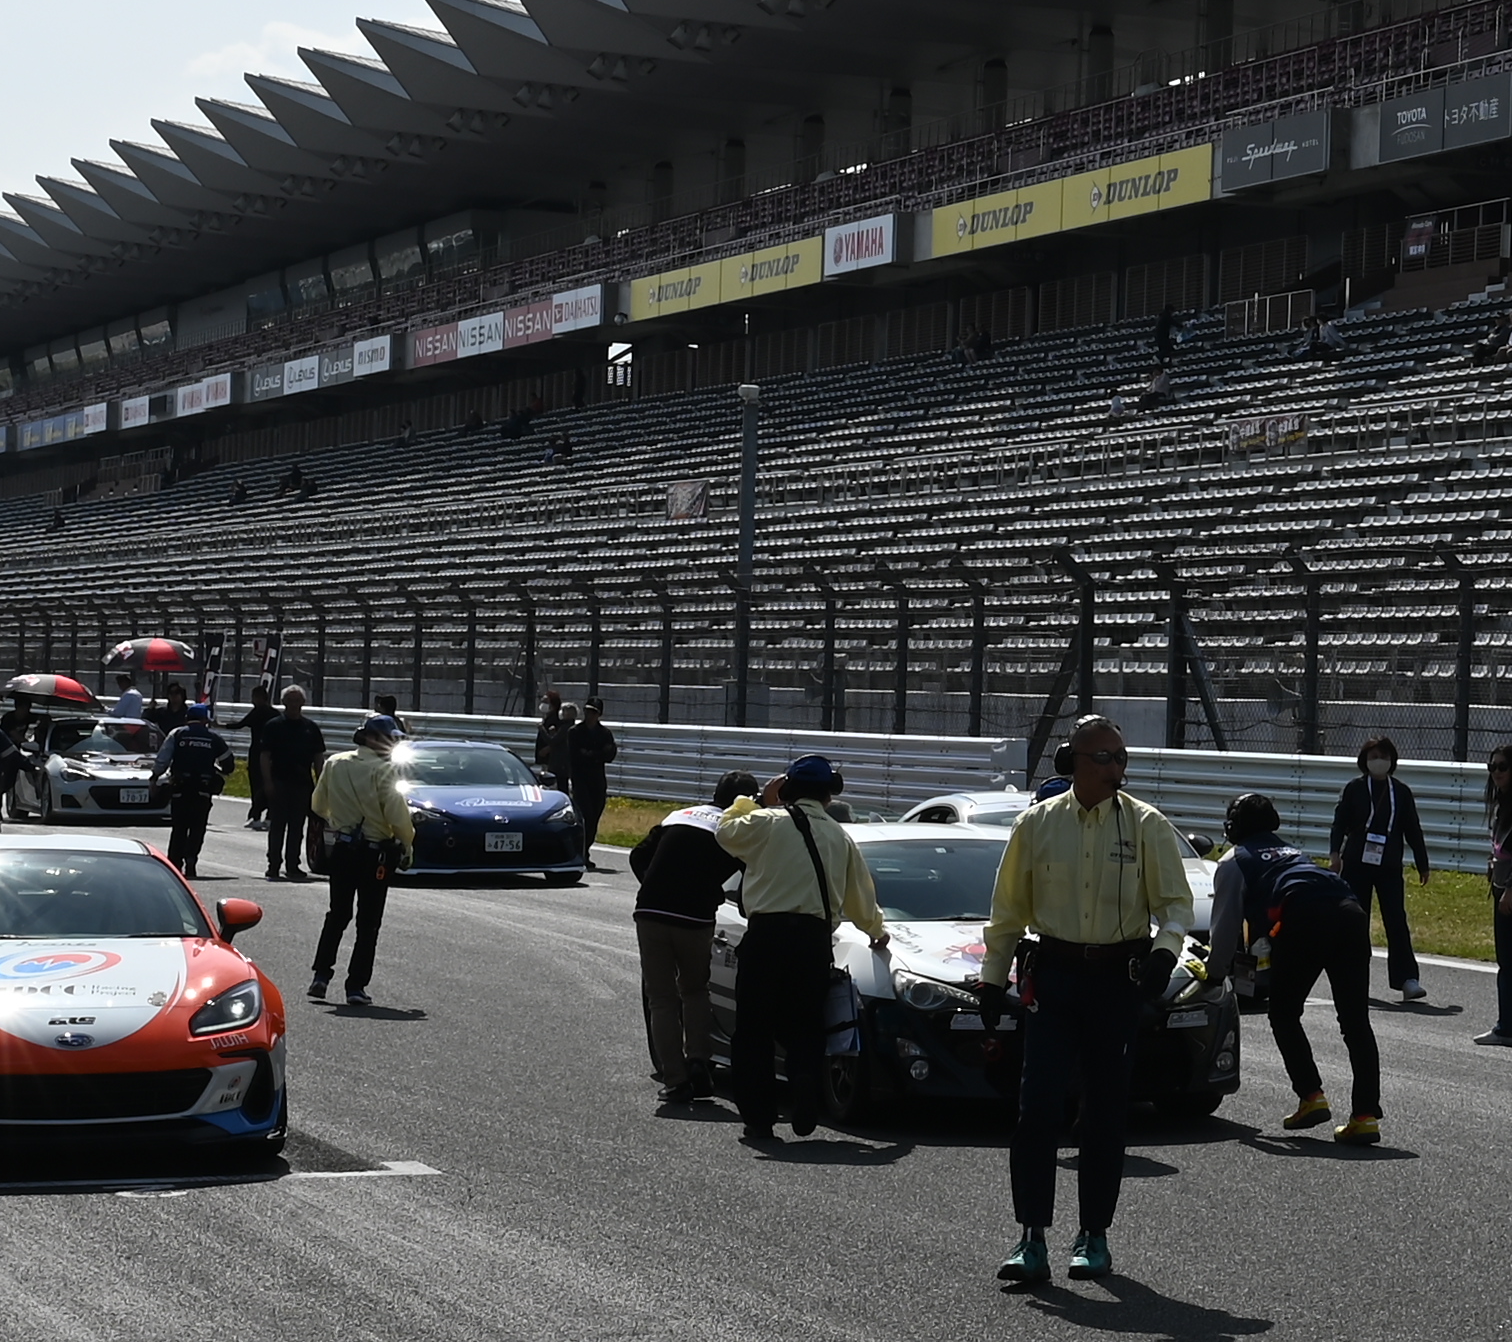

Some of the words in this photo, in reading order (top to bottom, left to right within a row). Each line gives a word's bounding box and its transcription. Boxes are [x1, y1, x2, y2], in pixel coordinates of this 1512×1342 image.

[1396, 107, 1428, 126] TOYOTA
[1241, 137, 1298, 170] Speedway
[1102, 167, 1179, 206] DUNLOP
[967, 201, 1034, 236] DUNLOP
[843, 225, 885, 263] YAMAHA
[748, 253, 800, 283] DUNLOP
[655, 275, 702, 303] DUNLOP
[564, 294, 600, 323] DAIHATSU
[458, 321, 503, 349] NISSAN
[504, 309, 552, 340] NISSAN
[415, 330, 457, 359] NISSAN
